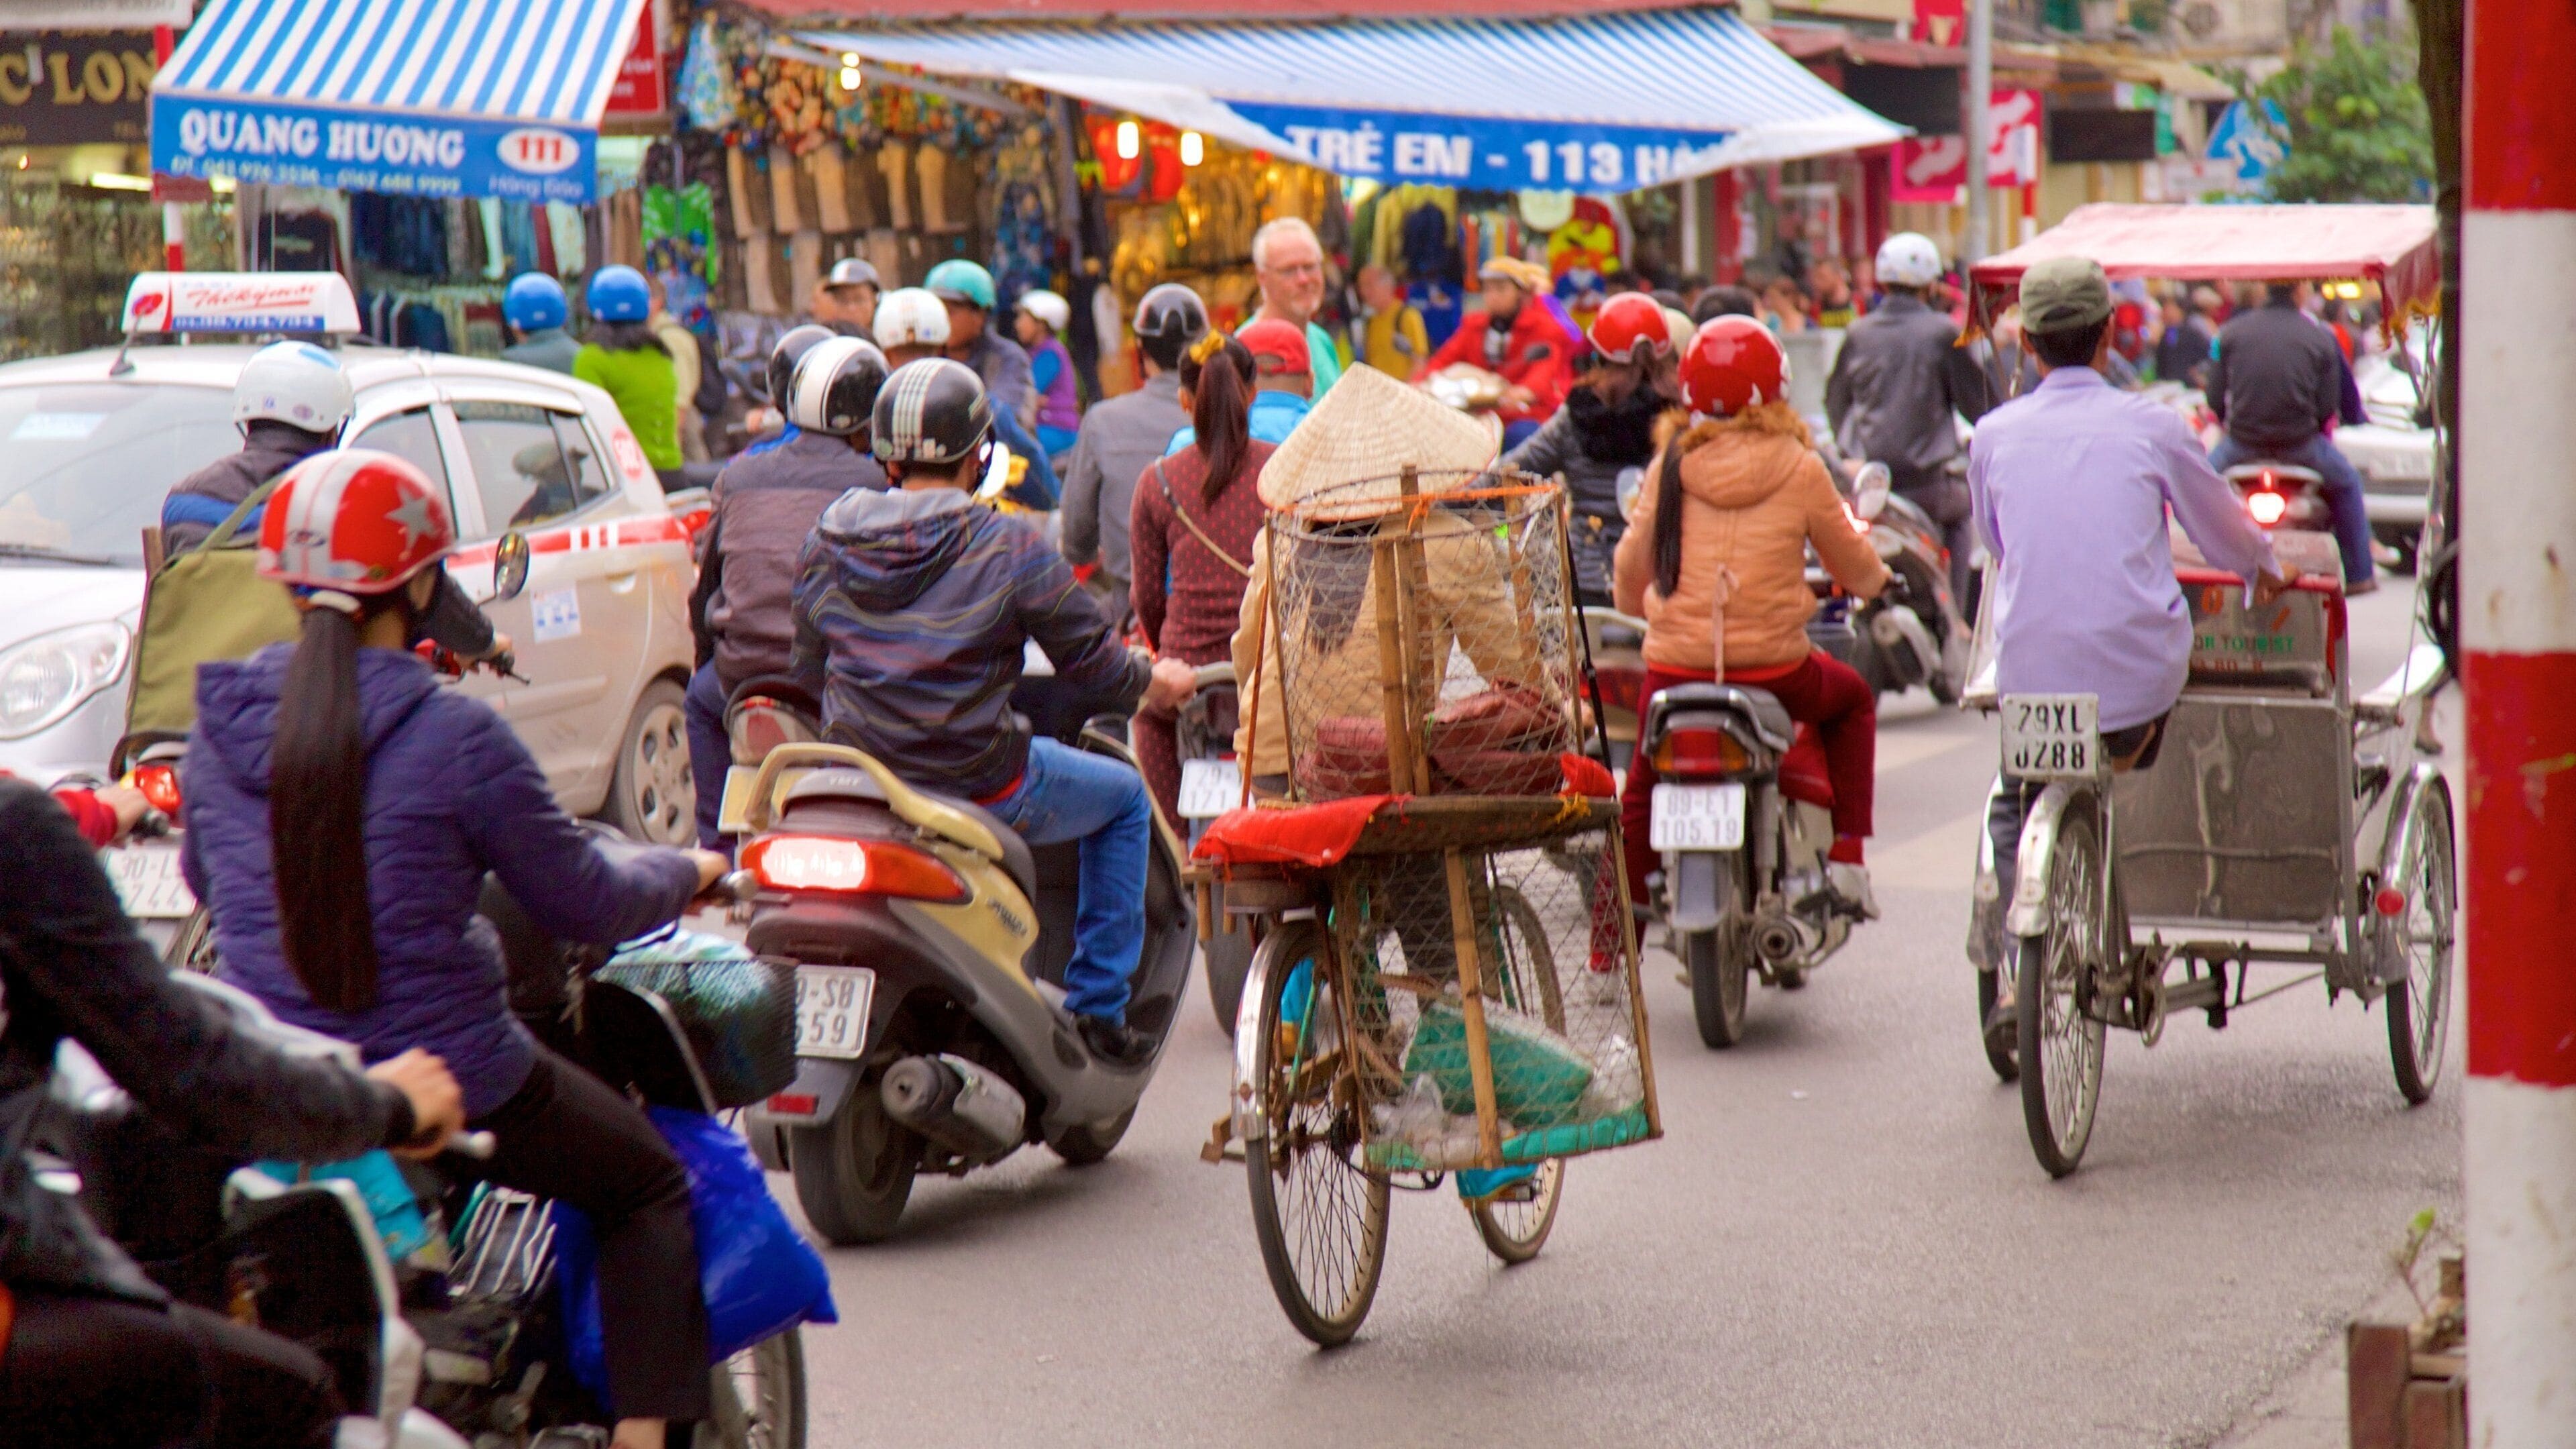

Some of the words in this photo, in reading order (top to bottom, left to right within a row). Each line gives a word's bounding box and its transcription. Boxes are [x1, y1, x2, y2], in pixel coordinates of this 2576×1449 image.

[178, 109, 319, 158] QUANG
[517, 136, 562, 162] 111
[1521, 140, 1623, 184] 113
[2015, 741, 2085, 769] 0288
